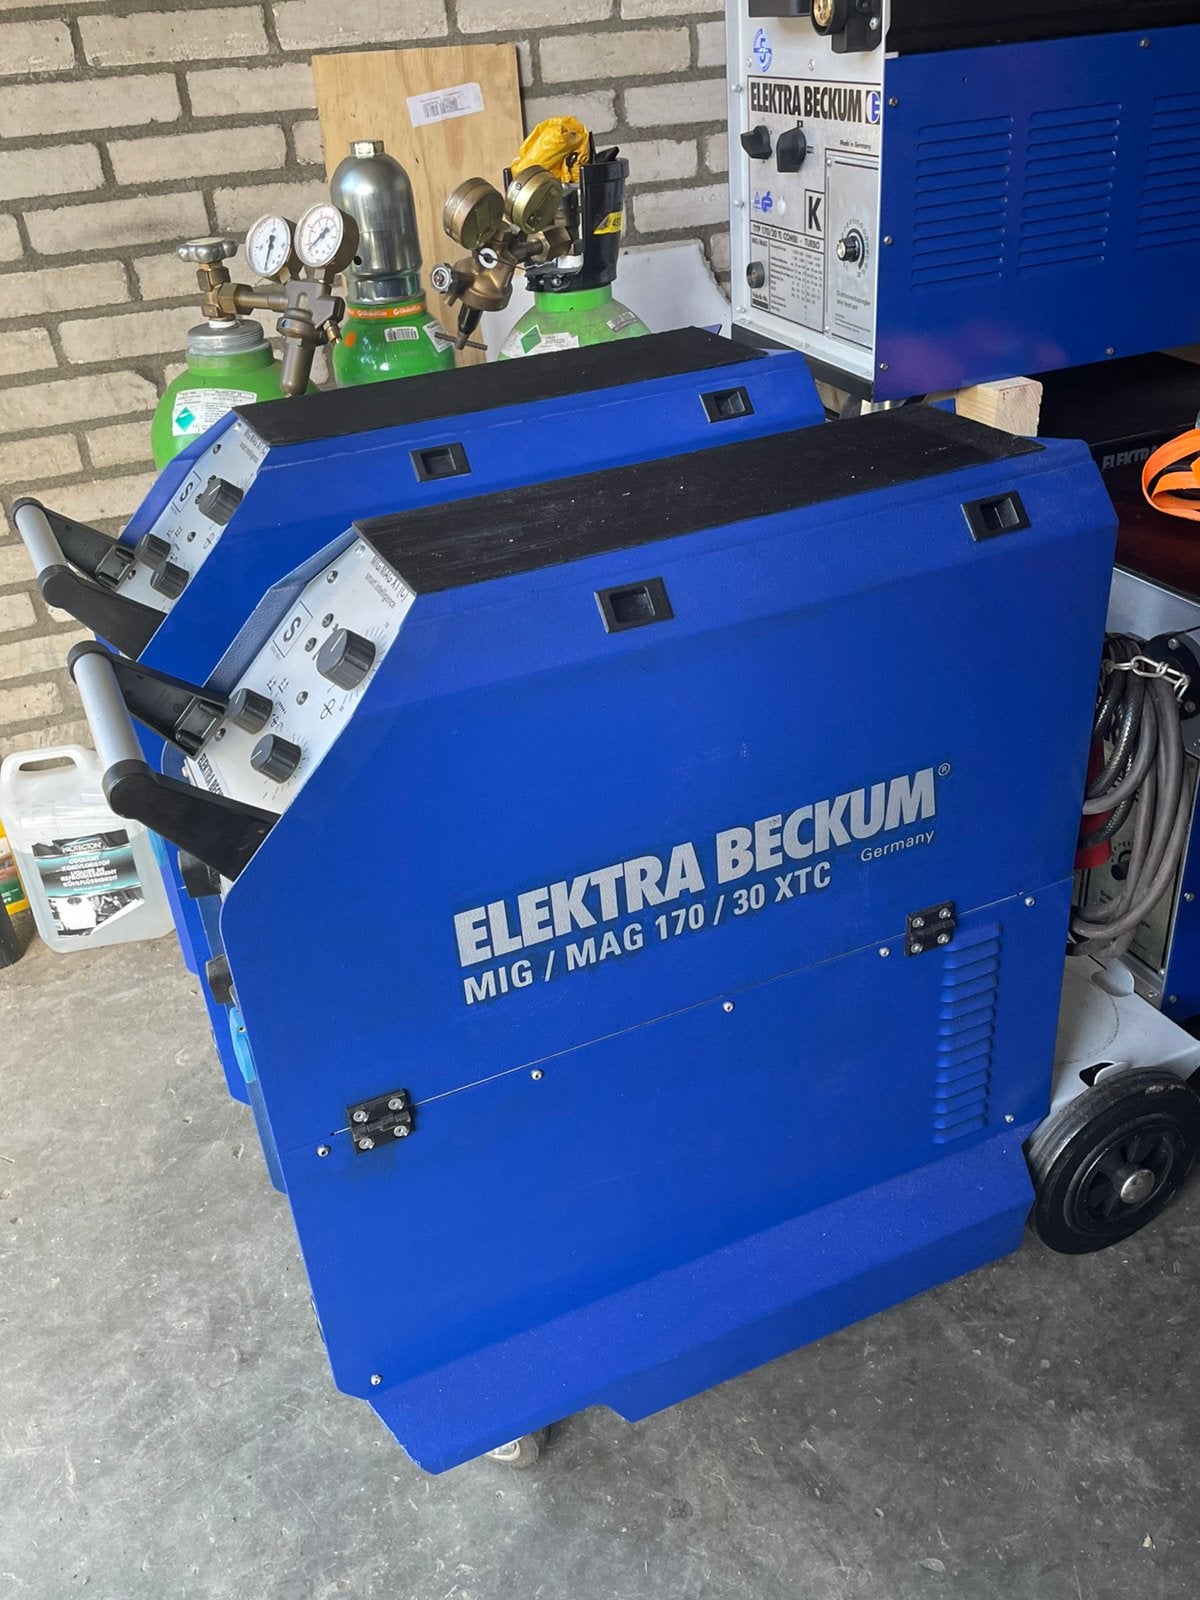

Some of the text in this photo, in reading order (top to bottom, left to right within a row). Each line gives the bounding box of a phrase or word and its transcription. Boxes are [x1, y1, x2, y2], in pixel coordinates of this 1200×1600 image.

[751, 82, 802, 116] ELEKTRA
[804, 86, 862, 123] BECKUM
[808, 196, 822, 232] K
[804, 238, 821, 249] TURBO
[282, 616, 302, 643] S
[69, 855, 99, 864] COOLANT
[861, 829, 935, 863] Germany
[453, 842, 705, 968] ELEKTRA
[715, 766, 938, 884] BECKUM
[463, 862, 832, 1005] MIG / MAG 170 / 30 XTC
